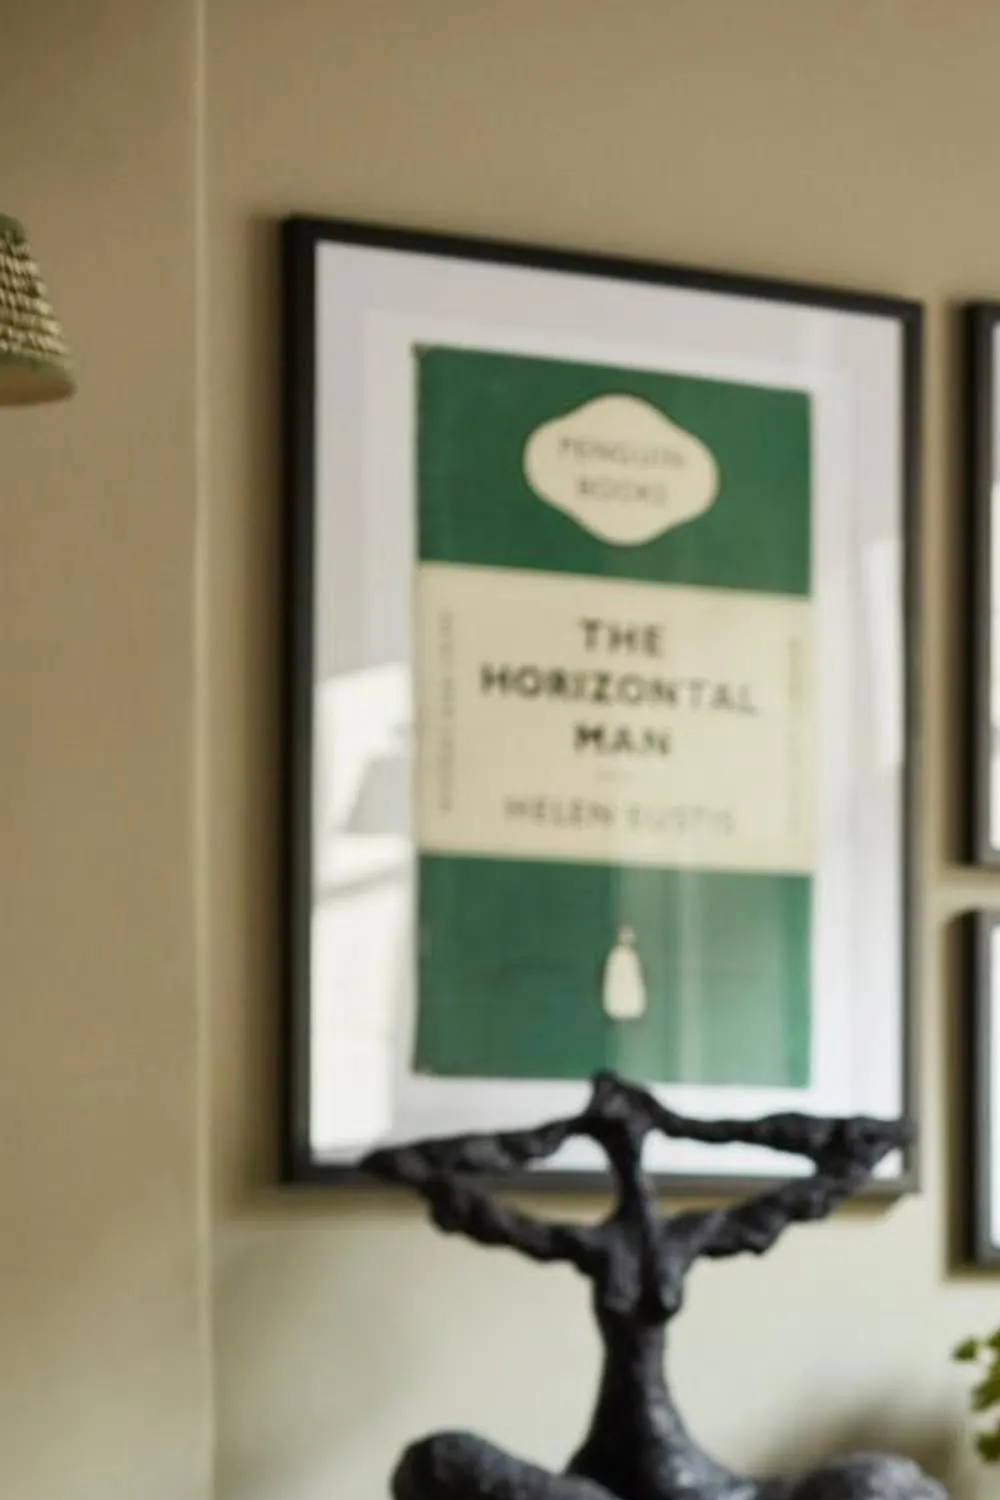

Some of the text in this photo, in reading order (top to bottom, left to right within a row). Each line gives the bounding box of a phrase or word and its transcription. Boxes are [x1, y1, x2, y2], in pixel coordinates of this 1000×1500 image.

[579, 617, 666, 658] THE
[480, 663, 760, 714] HORIZONTAL
[573, 723, 672, 757] MAN
[504, 795, 616, 830] HELEN
